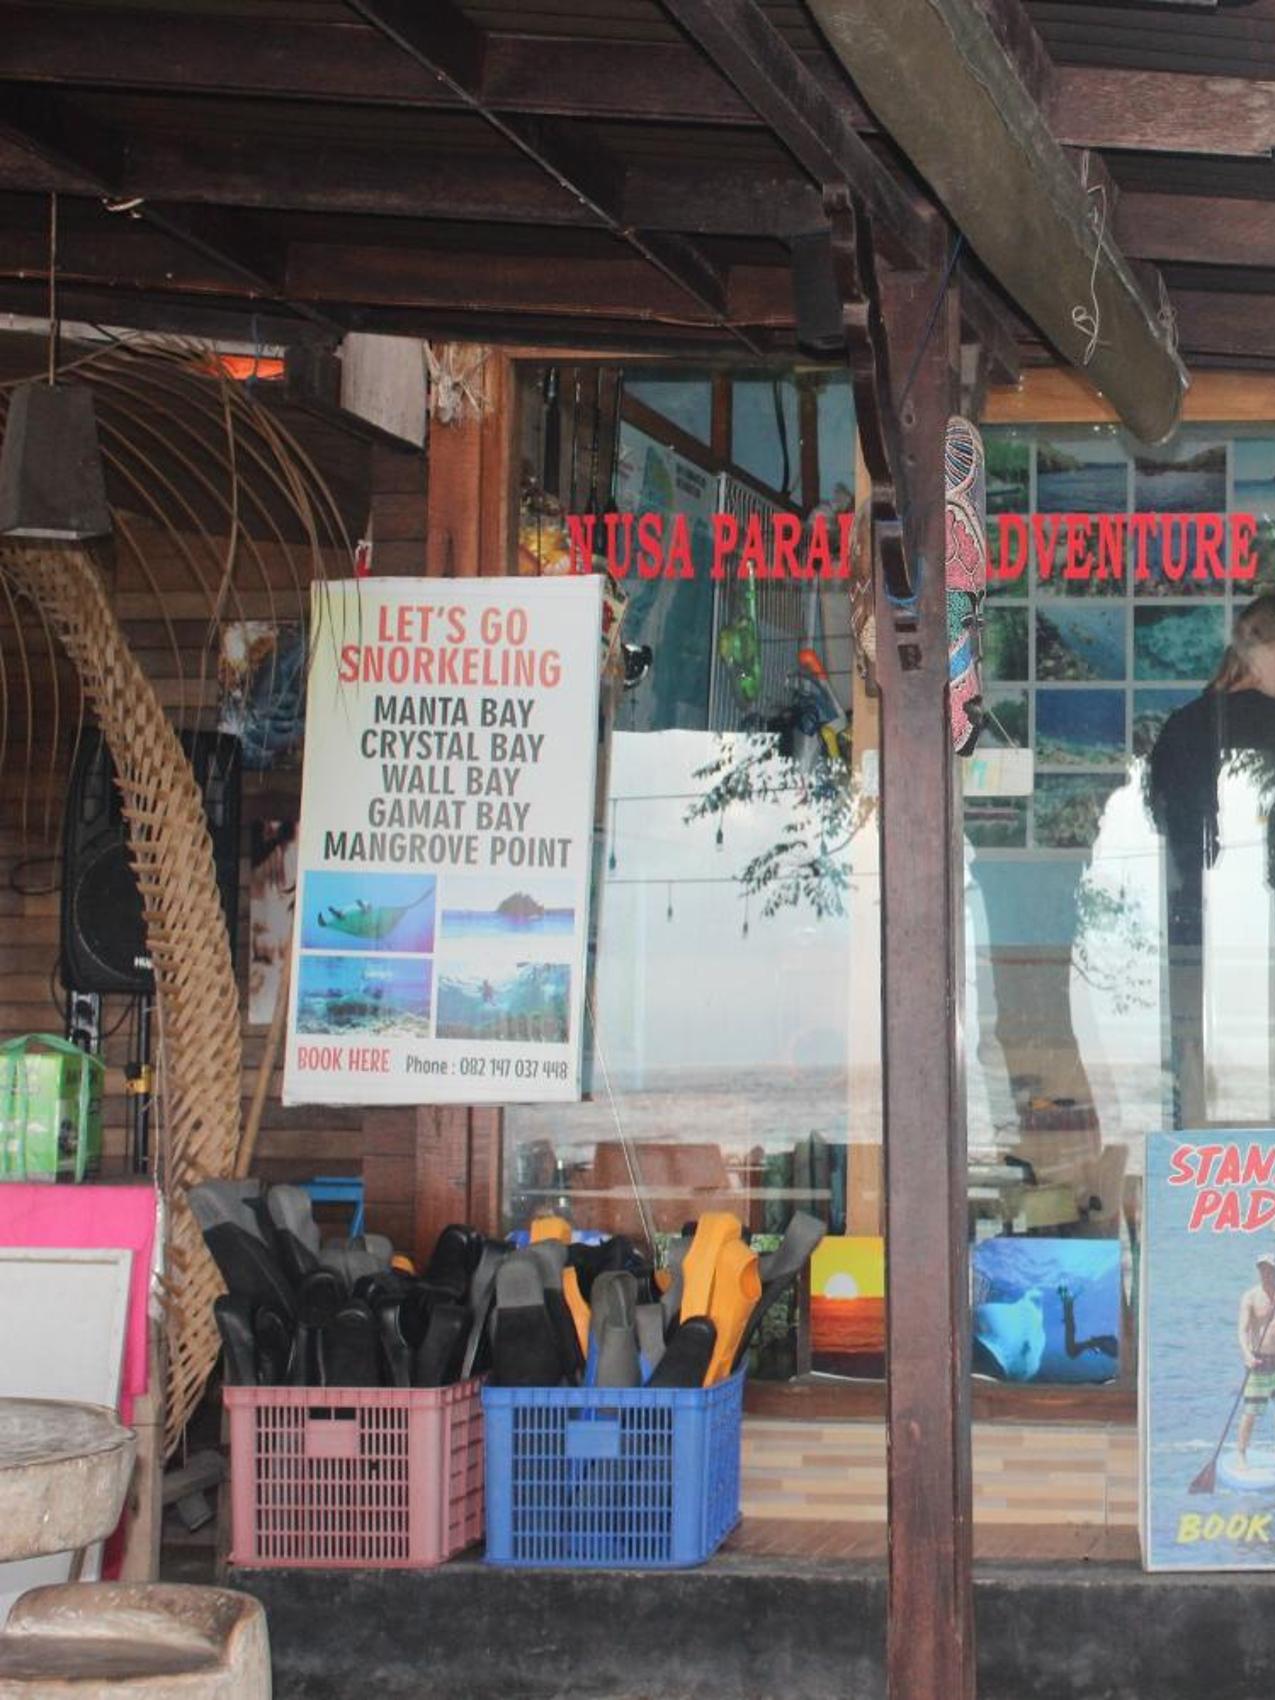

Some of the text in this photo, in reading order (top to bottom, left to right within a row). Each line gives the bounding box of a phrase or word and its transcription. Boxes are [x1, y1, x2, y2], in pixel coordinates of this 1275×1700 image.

[565, 511, 694, 580] NUSA
[710, 511, 855, 579] PARA
[378, 605, 528, 645] LET'S GO
[339, 645, 562, 688] SNORKELING
[374, 695, 534, 729] MANTA BAY
[360, 728, 545, 762] CRYSTAL BAY
[381, 764, 521, 797] WALL BAY
[367, 797, 531, 832] GAMAT BAY
[323, 830, 572, 868] MANGROVE POINT
[297, 1046, 344, 1072] BOOK
[348, 1048, 391, 1073] HERE
[405, 1054, 448, 1075] Phone
[459, 1056, 486, 1076] 082
[490, 1058, 511, 1078] 147
[514, 1058, 539, 1079] 037
[541, 1059, 569, 1080] 448
[1176, 1511, 1274, 1544] BOOK
